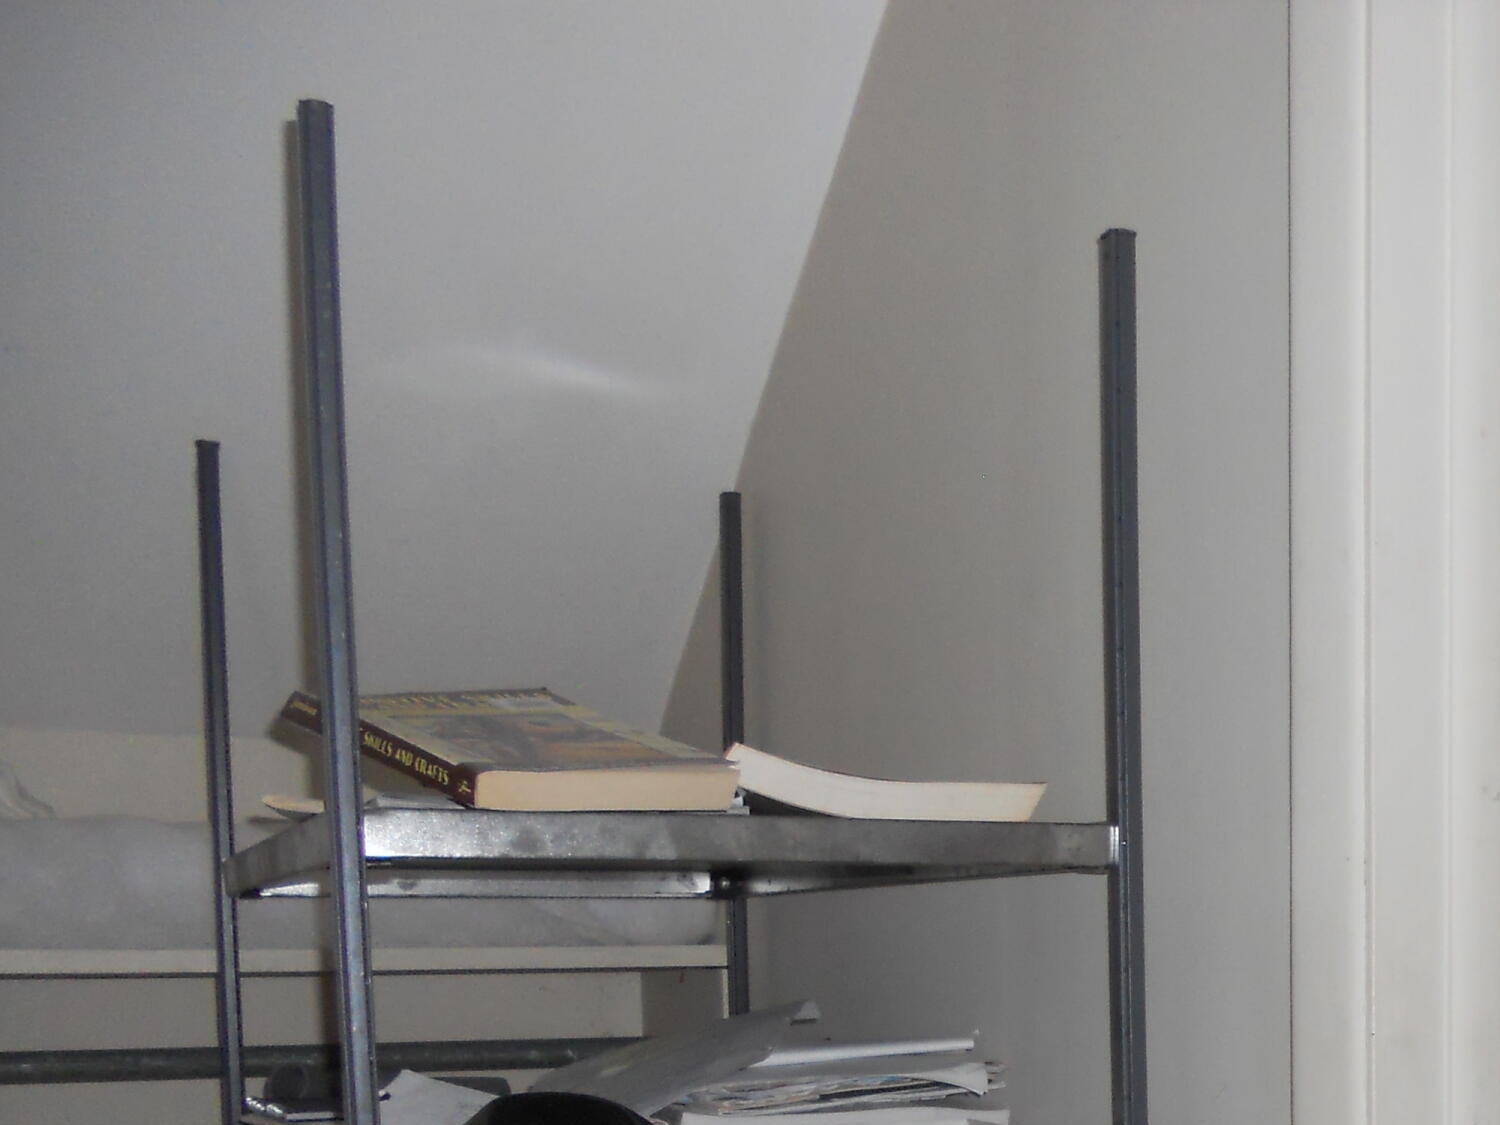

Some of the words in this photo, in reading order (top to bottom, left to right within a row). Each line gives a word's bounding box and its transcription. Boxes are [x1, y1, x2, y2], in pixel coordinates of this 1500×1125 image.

[363, 730, 394, 758] SKILLS
[394, 748, 414, 767] AND
[415, 755, 449, 786] CRAFTS
